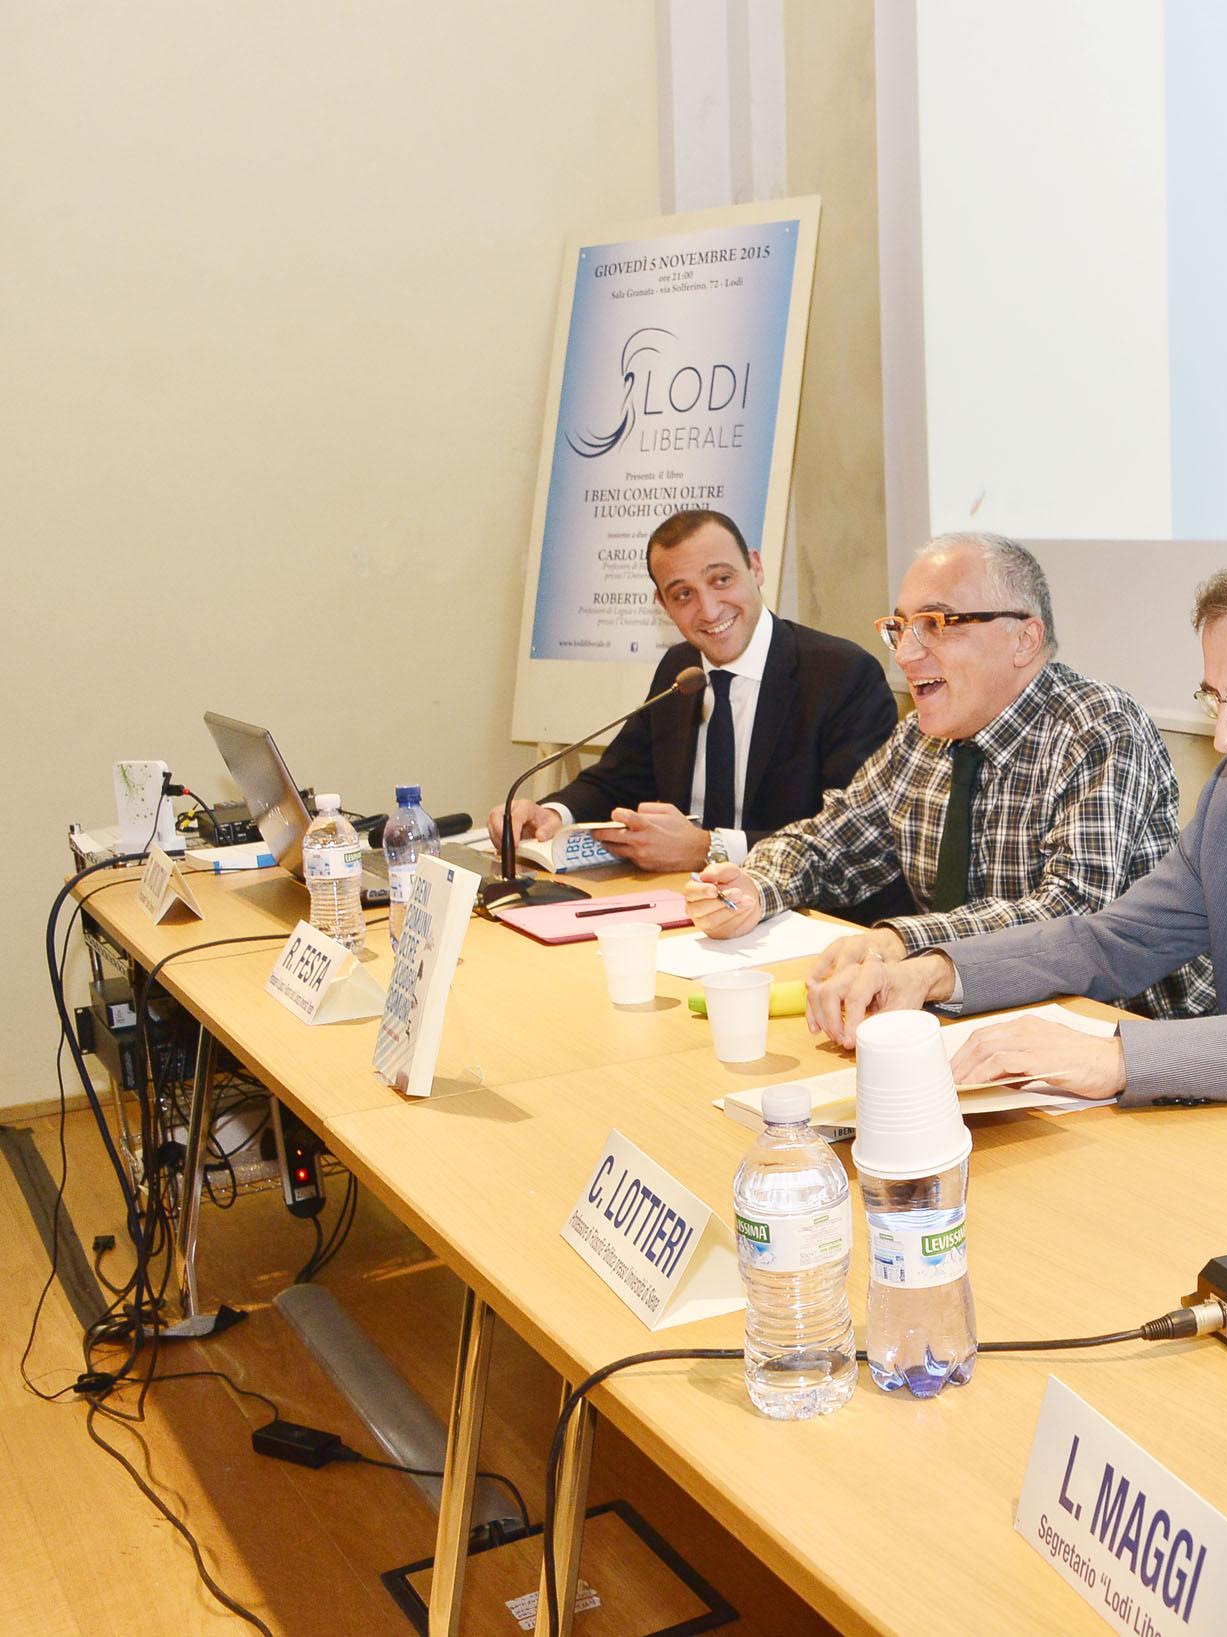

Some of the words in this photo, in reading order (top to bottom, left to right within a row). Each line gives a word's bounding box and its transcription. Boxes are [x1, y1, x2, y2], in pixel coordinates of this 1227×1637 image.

[594, 256, 648, 279] GIOVEDÌ
[649, 260, 657, 271] 5
[658, 248, 737, 270] NOVEMBRE
[740, 245, 771, 261] 2015
[643, 362, 751, 416] LODI
[639, 423, 745, 453] LIBERALE
[592, 488, 621, 502] BENI
[623, 487, 678, 501] COMUNI
[680, 485, 725, 499] OLTRE
[600, 504, 651, 518] LUOGHI
[598, 548, 638, 561] CARLO
[593, 592, 648, 605] ROBERTO
[282, 937, 301, 971] R.
[293, 944, 332, 993] FESTA
[588, 1154, 615, 1209] C.
[603, 1169, 694, 1279] LOTTIERI
[738, 1218, 768, 1241] ISSIMA
[1058, 1434, 1083, 1521] L.
[1090, 1462, 1208, 1624] MAGGI
[1037, 1514, 1097, 1589] Segretario
